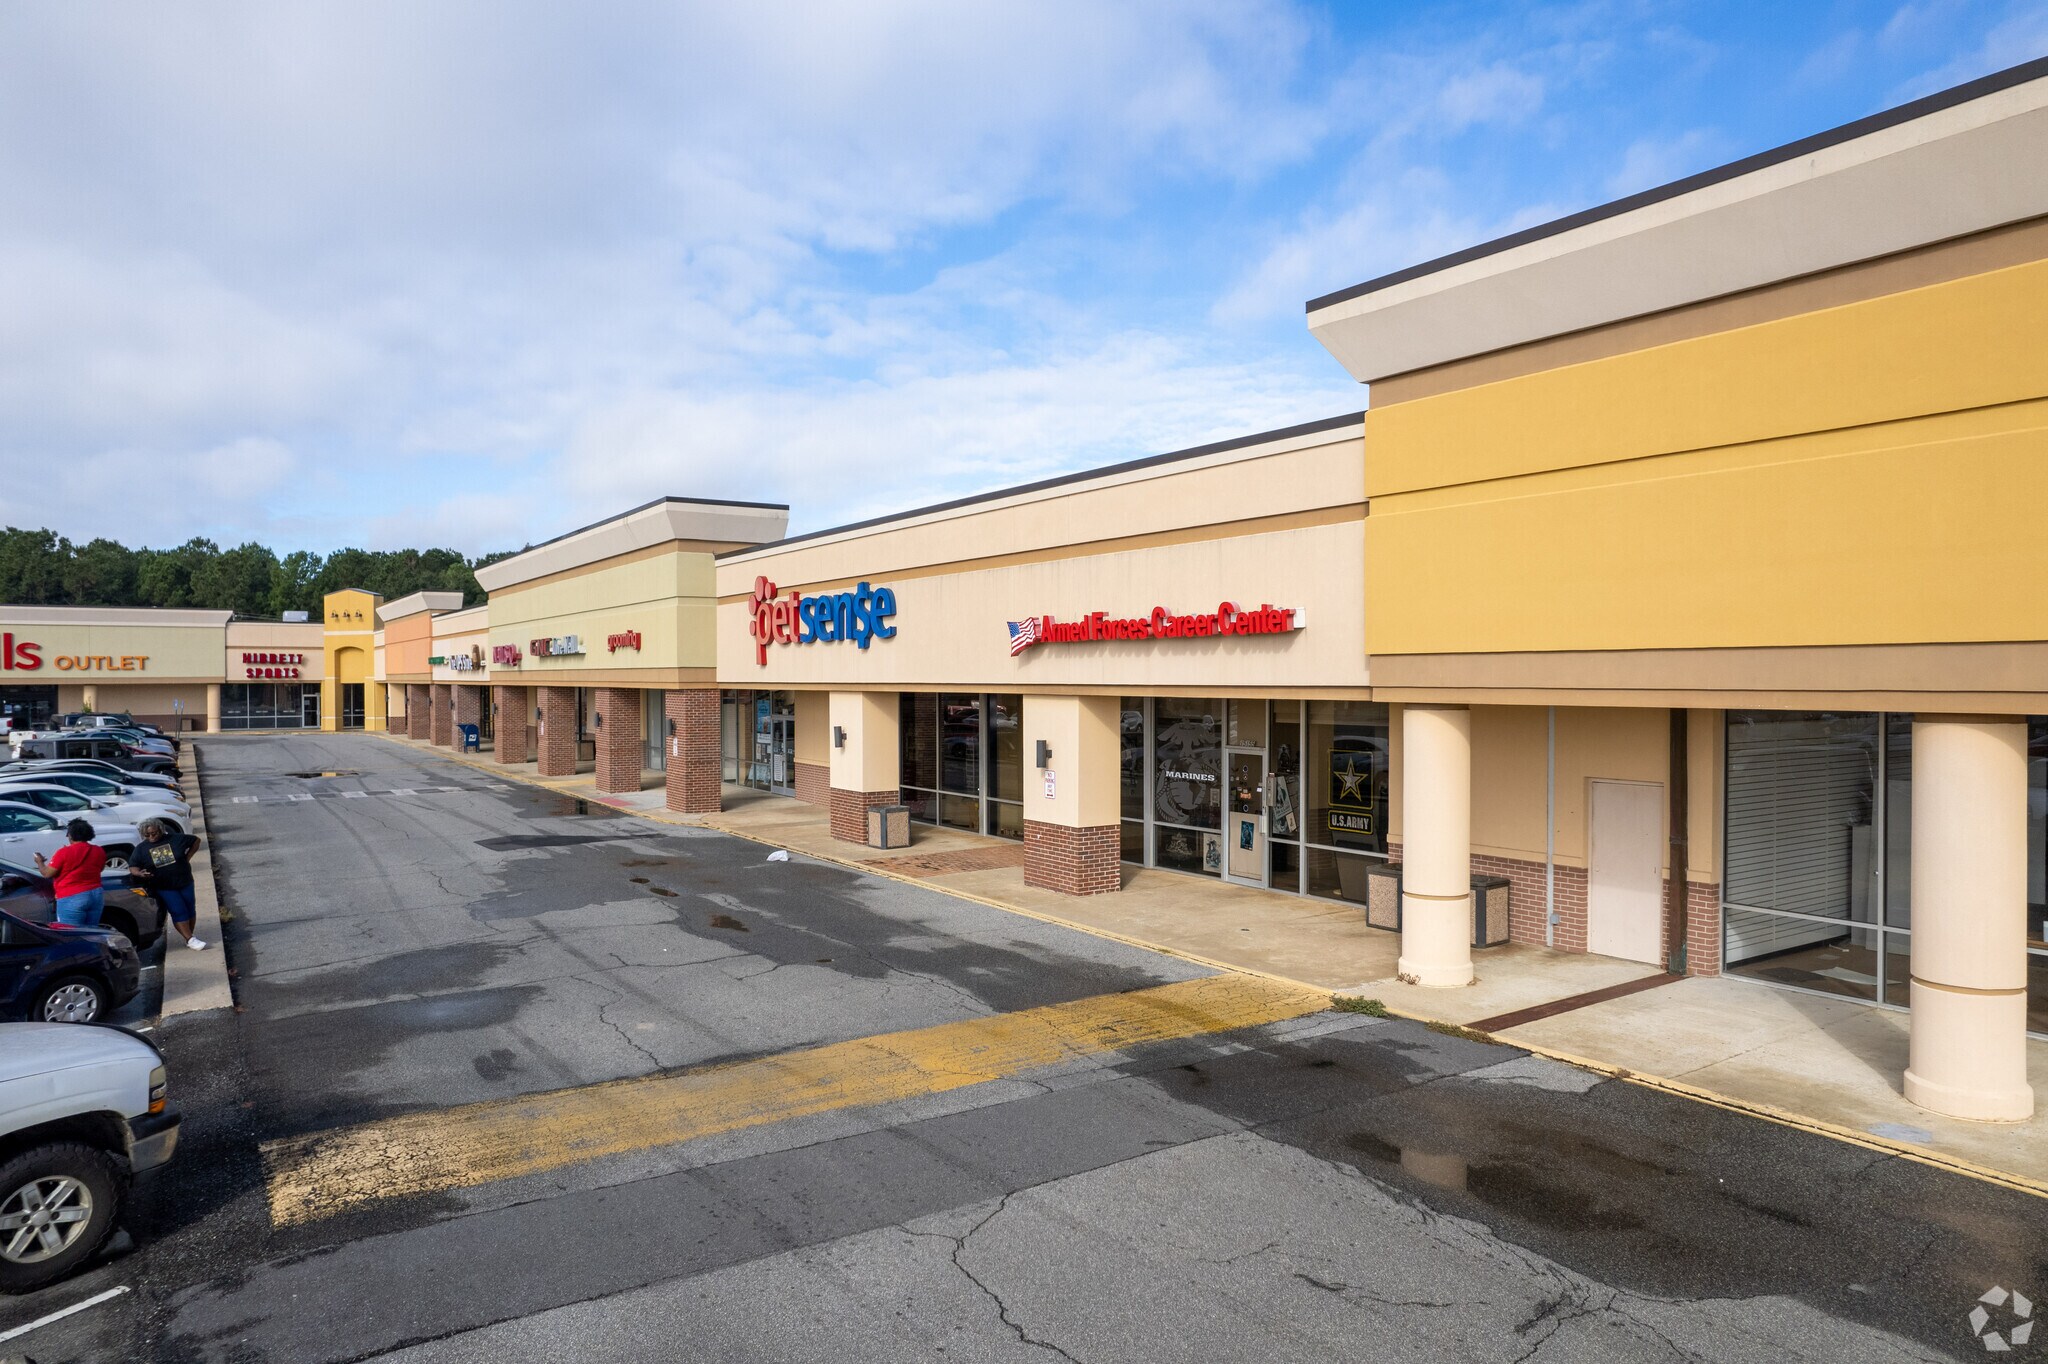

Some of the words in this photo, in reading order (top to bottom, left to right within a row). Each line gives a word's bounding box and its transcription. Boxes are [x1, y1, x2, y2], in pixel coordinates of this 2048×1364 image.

[1041, 615, 1090, 642] Armed
[1091, 611, 1149, 641] Forces
[1151, 606, 1215, 639] Career
[1217, 601, 1293, 637] Center
[608, 629, 641, 652] grooming
[54, 655, 149, 671] OUTLET
[246, 667, 299, 678] SPORTS
[1165, 770, 1215, 782] MARINES
